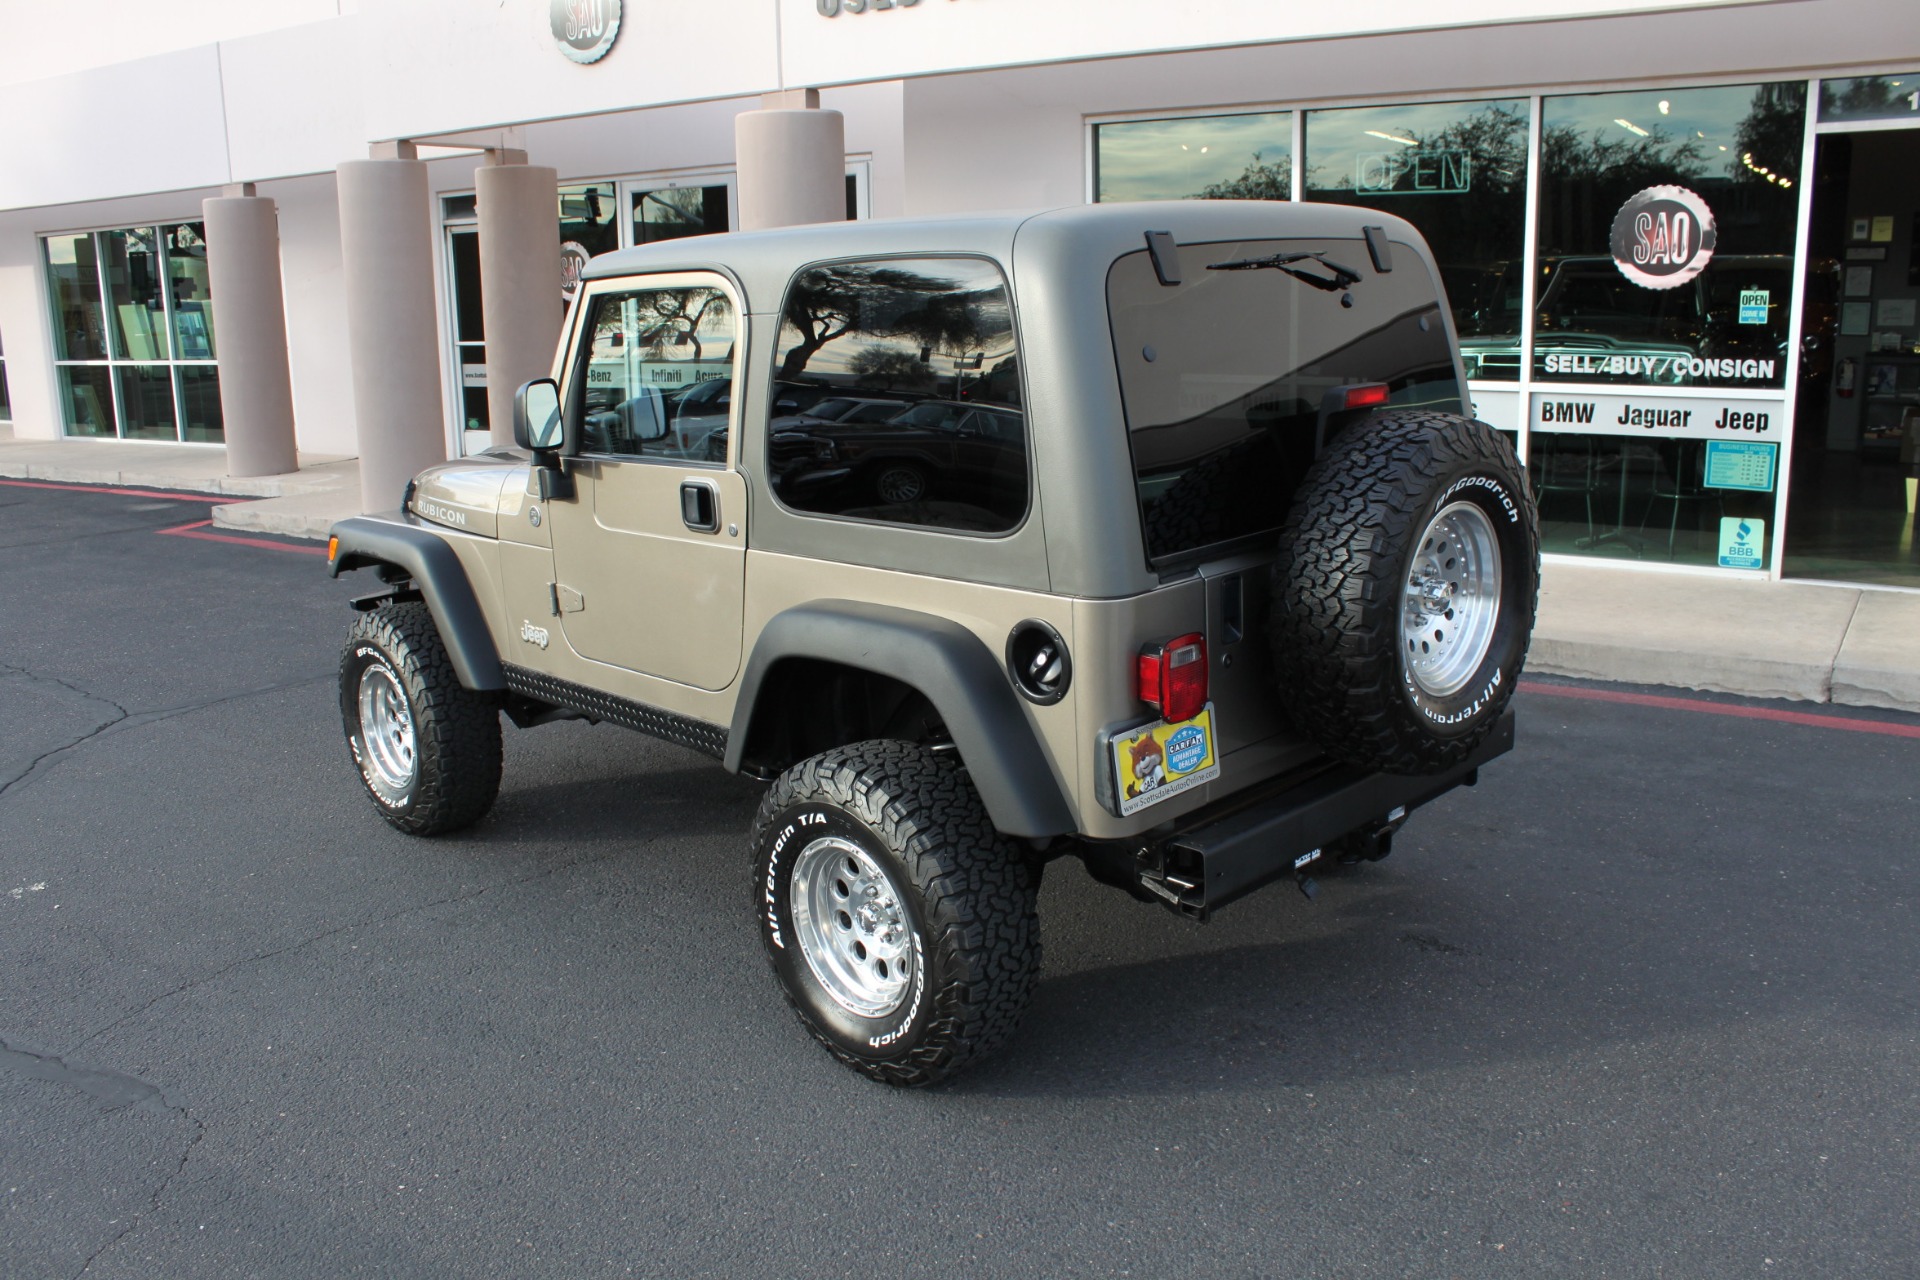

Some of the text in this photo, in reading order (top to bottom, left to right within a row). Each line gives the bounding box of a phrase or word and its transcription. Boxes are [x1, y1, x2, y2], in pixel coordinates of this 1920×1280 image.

[1361, 153, 1465, 190] OPEN
[1633, 210, 1691, 266] SAO
[1742, 294, 1767, 306] OPEN
[651, 368, 682, 383] Infiniti
[1541, 401, 1770, 433] BMW Jaguar Jeep
[418, 499, 466, 525] RUBICON
[1434, 476, 1519, 523] BFGoodrich
[1729, 546, 1753, 557] BBB
[521, 619, 549, 650] Jeep
[1424, 667, 1502, 724] All-Terrain
[1169, 734, 1203, 754] CARFAX
[1178, 757, 1198, 770] DEALER
[766, 812, 828, 949] All-Terrain T/A
[868, 931, 925, 1049] BFGoodrich
